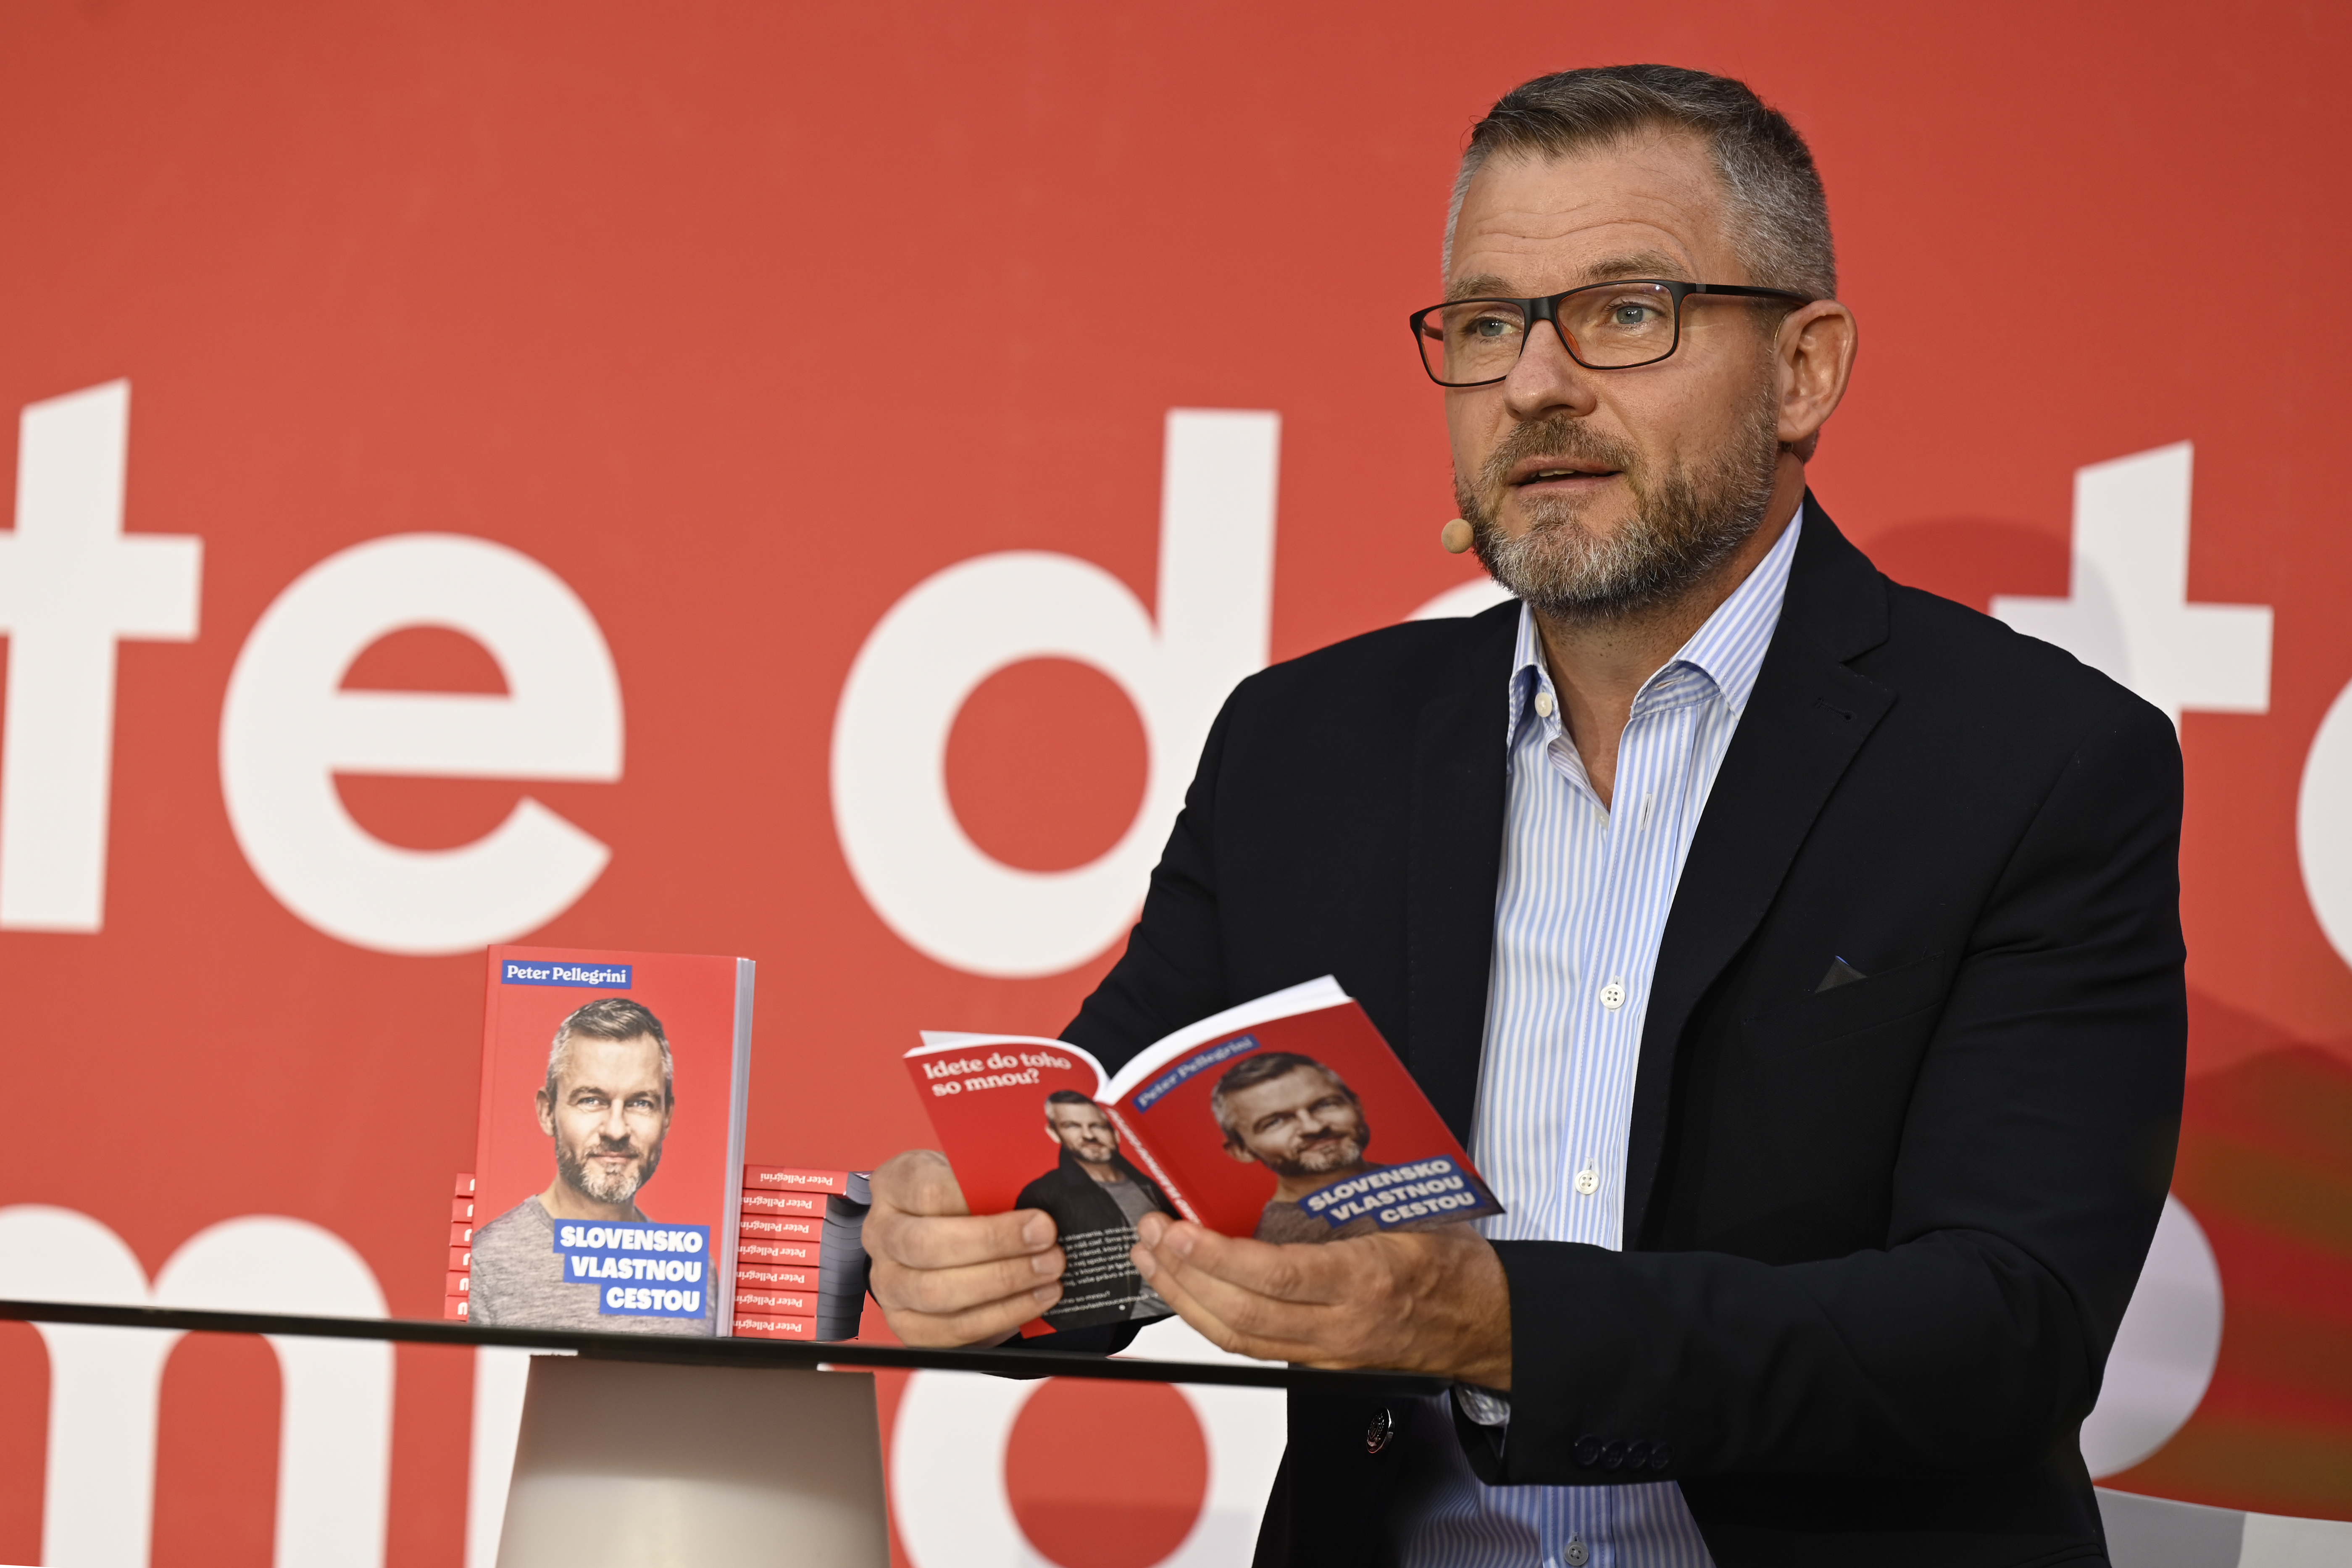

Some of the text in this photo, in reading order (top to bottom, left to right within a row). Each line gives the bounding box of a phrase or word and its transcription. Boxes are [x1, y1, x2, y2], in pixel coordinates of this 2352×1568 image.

[507, 965, 626, 985] Peter Pellegrini
[922, 1051, 1072, 1080] Idete do toho
[1138, 1036, 1253, 1107] Peter Pellegrini
[931, 1067, 1041, 1097] so mnou?
[760, 1172, 834, 1186] Peter Pellegrini
[1307, 1159, 1452, 1212] SLOVENSKO
[786, 1199, 813, 1209] Peter
[1329, 1175, 1465, 1221] VLASTNOU
[1379, 1192, 1476, 1223] CESTOU
[560, 1225, 703, 1253] SLOVENSKO
[740, 1220, 810, 1234] Peter Pellegrin
[780, 1247, 806, 1258] Peter
[571, 1255, 702, 1283] VLASTNOU
[778, 1273, 805, 1284] Peter
[606, 1286, 700, 1312] CESTOU
[776, 1297, 803, 1308] Peter
[775, 1322, 802, 1333] Peter
